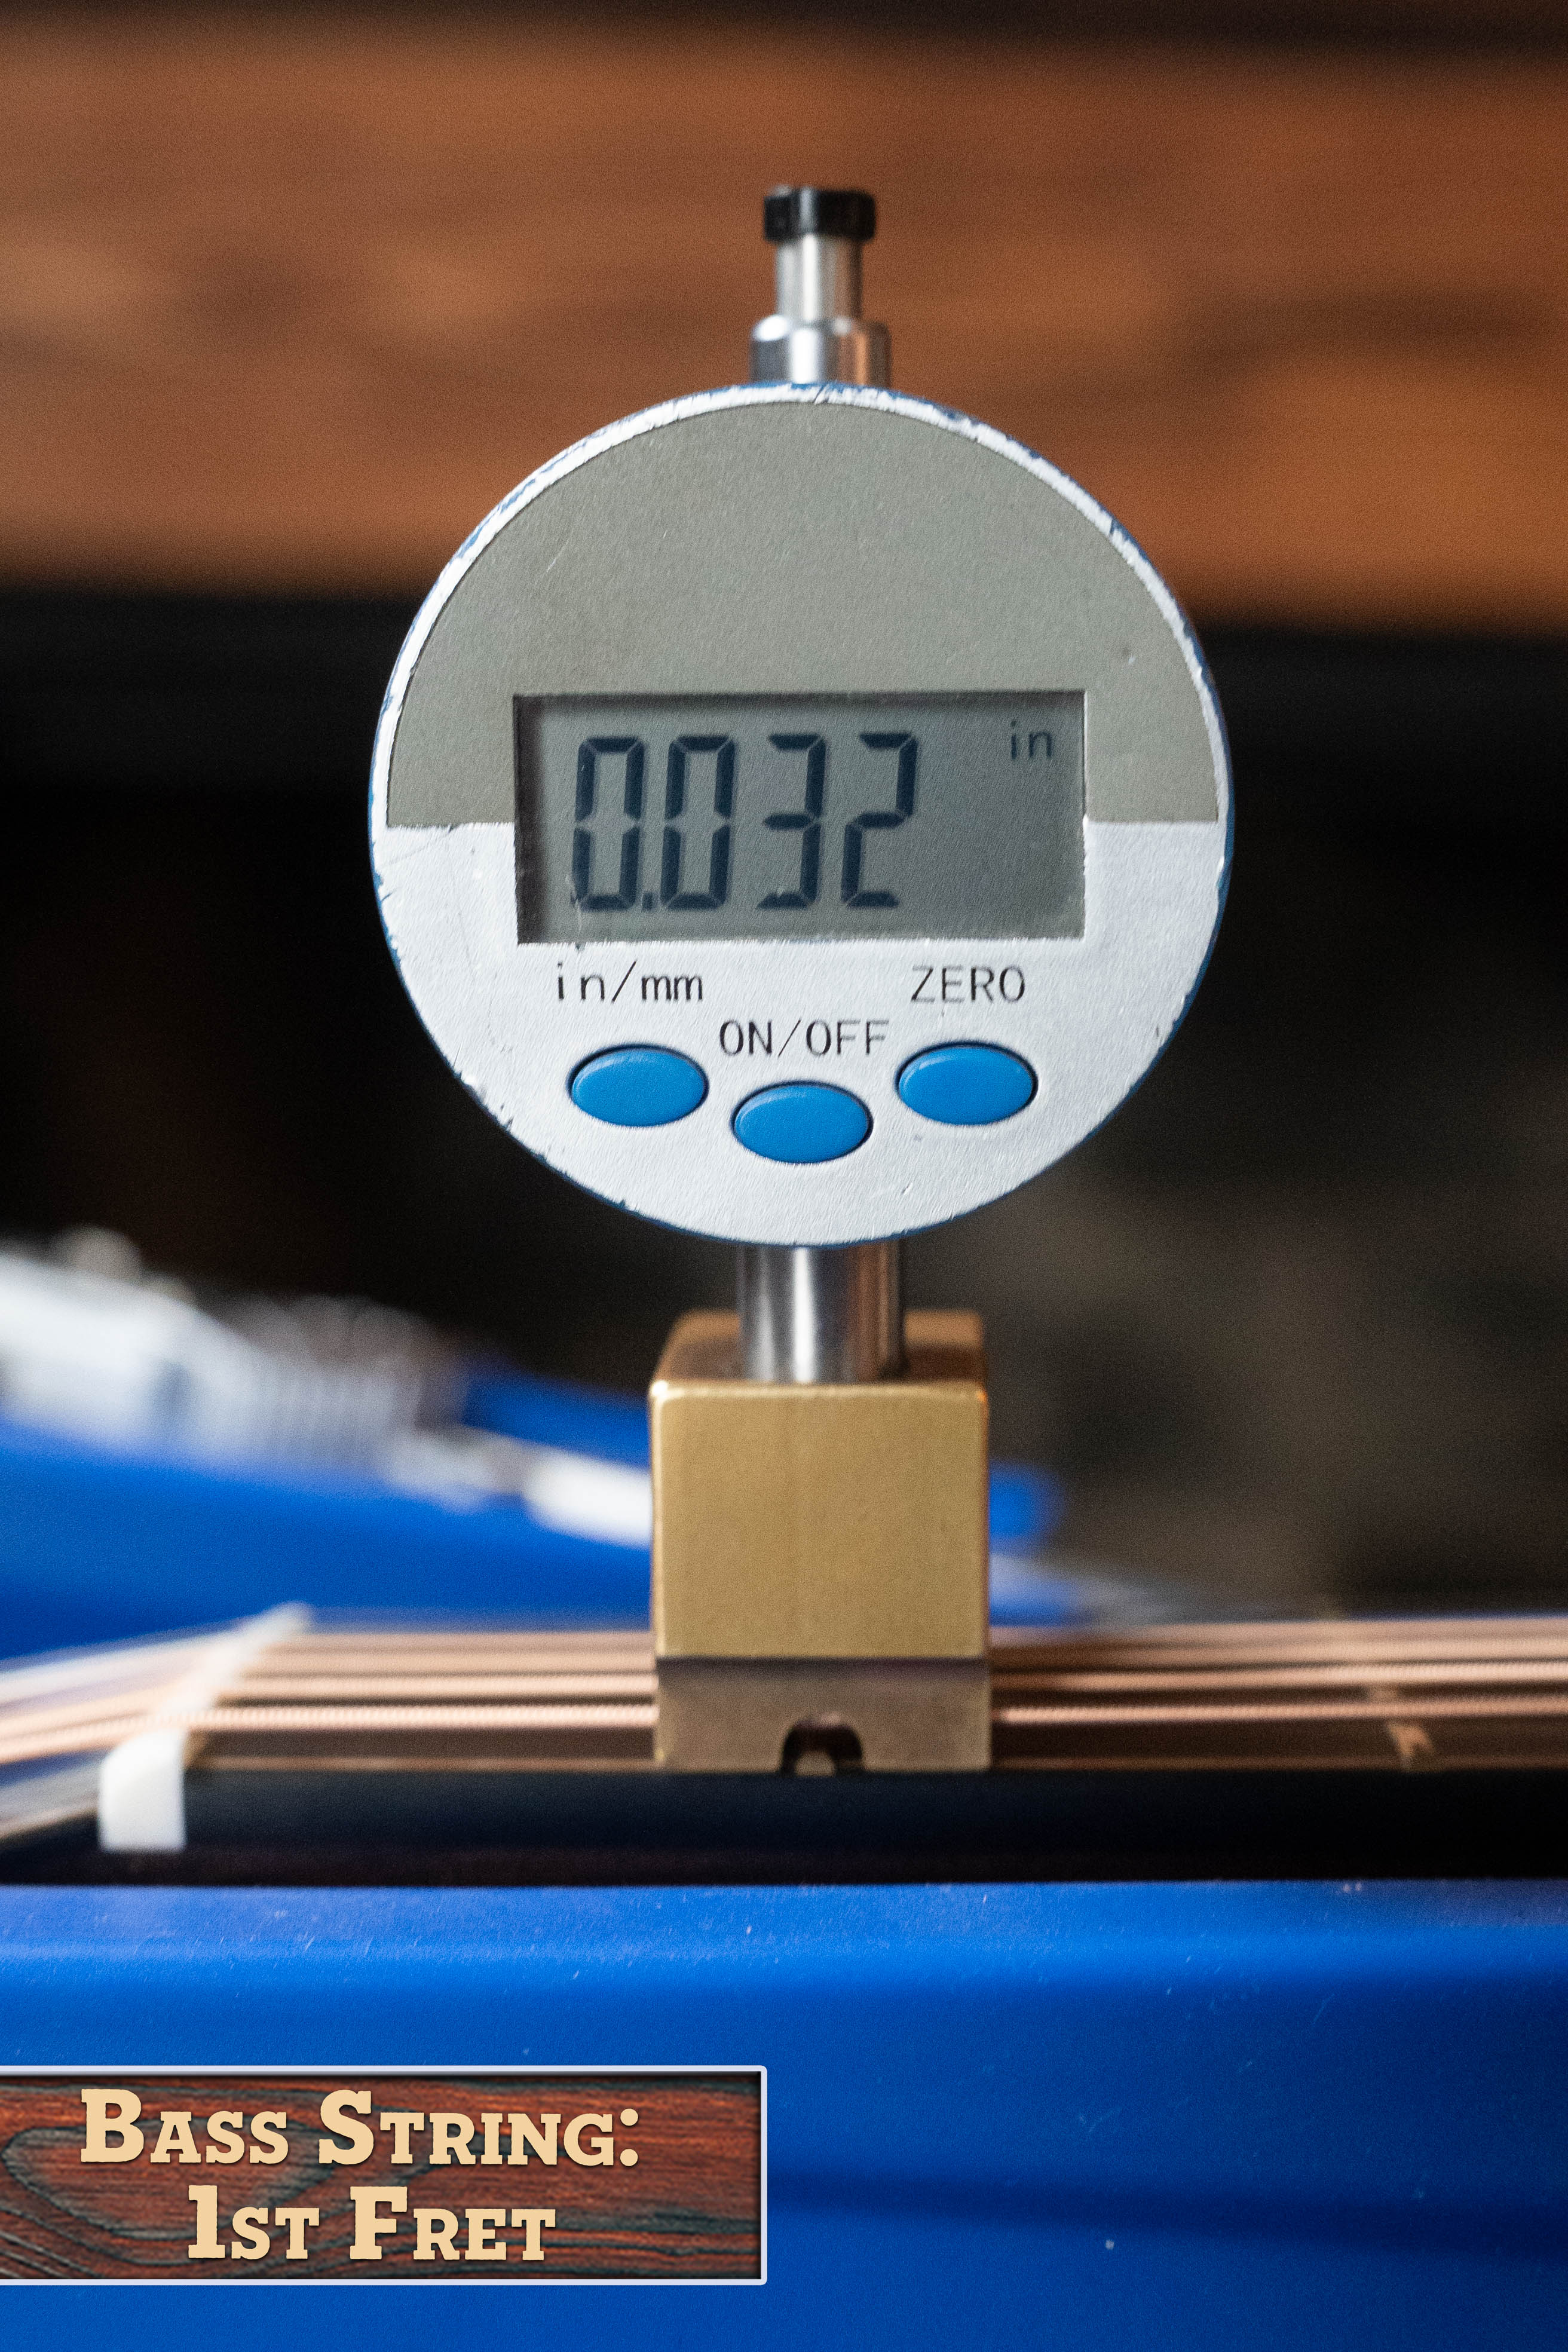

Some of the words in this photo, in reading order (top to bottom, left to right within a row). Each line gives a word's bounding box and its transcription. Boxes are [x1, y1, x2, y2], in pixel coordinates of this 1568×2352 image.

[570, 732, 919, 911] 0.032
[1007, 719, 1054, 761] in
[556, 959, 705, 1003] in/mm
[909, 965, 1026, 1004] ZERO
[718, 1018, 890, 1057] ON/OFF
